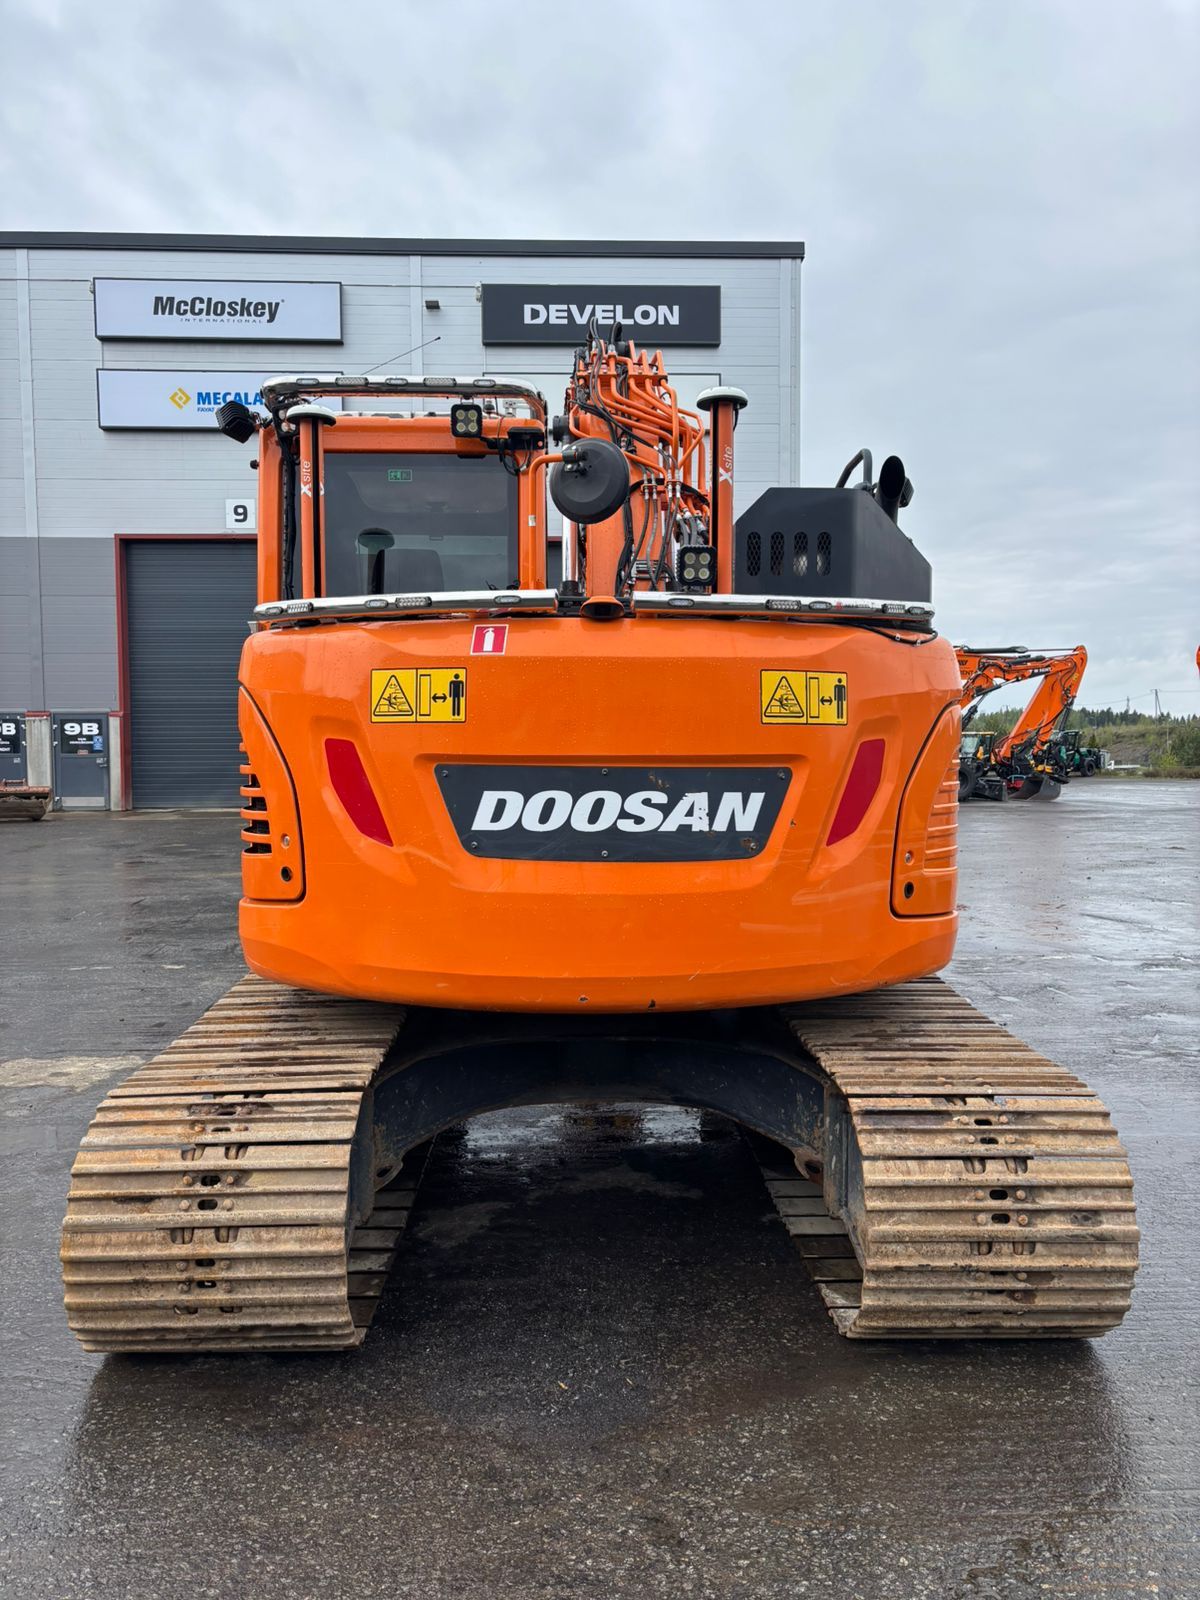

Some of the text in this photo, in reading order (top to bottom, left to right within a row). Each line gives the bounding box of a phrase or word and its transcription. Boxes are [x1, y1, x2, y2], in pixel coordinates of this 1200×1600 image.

[153, 296, 280, 323] McCloskey
[523, 304, 680, 325] DEVELON
[197, 392, 264, 405] MECALA
[233, 504, 248, 523] 9
[0, 722, 16, 735] B
[64, 722, 100, 735] 9B
[471, 790, 766, 832] DOOSAN
